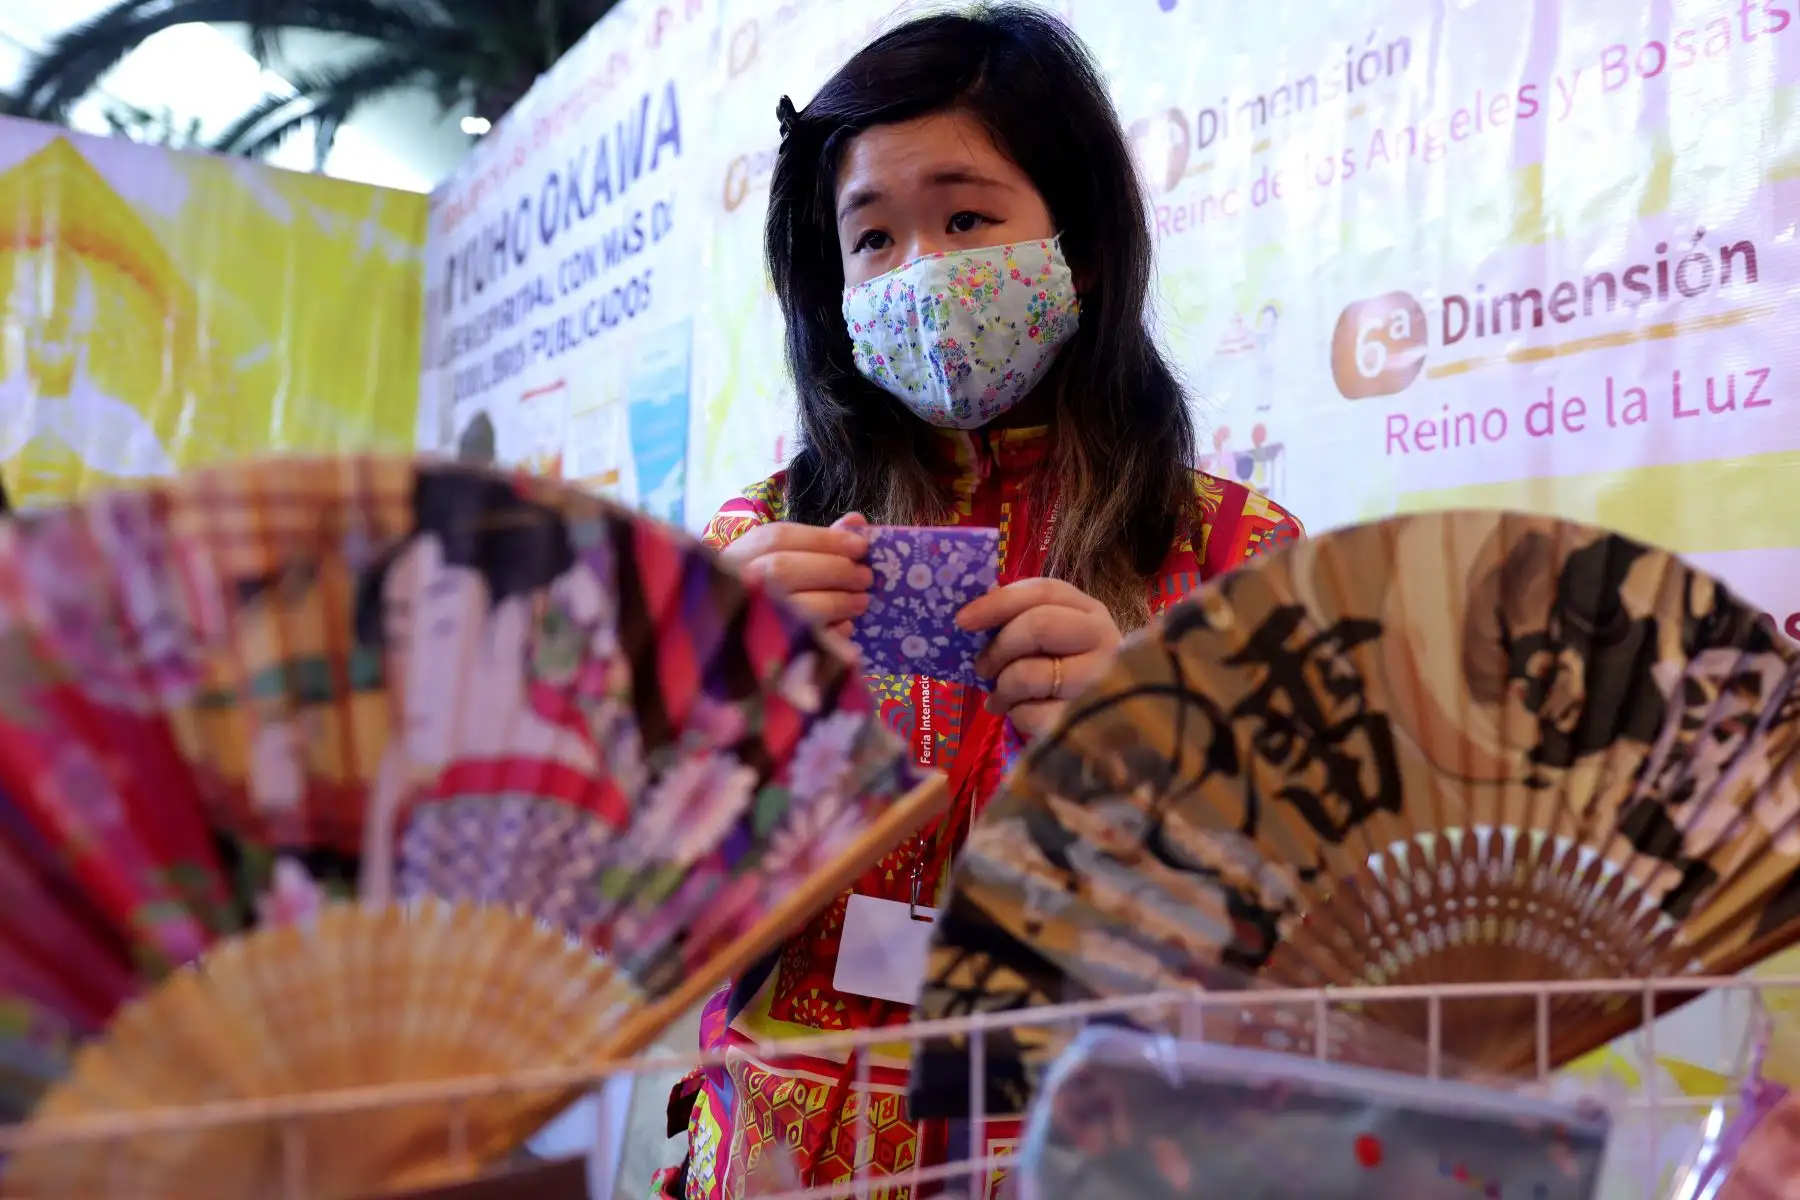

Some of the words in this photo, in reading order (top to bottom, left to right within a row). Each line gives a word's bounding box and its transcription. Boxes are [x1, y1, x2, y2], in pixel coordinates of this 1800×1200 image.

[1556, 69, 1583, 122] y
[1600, 0, 1800, 94] Bosats
[539, 77, 681, 246] OKAWA
[1442, 228, 1758, 345] Dimensión
[1385, 405, 1508, 455] Reino
[1524, 387, 1587, 437] de
[1606, 377, 1648, 428] la
[1673, 367, 1772, 419] Luz
[920, 735, 931, 764] Feria
